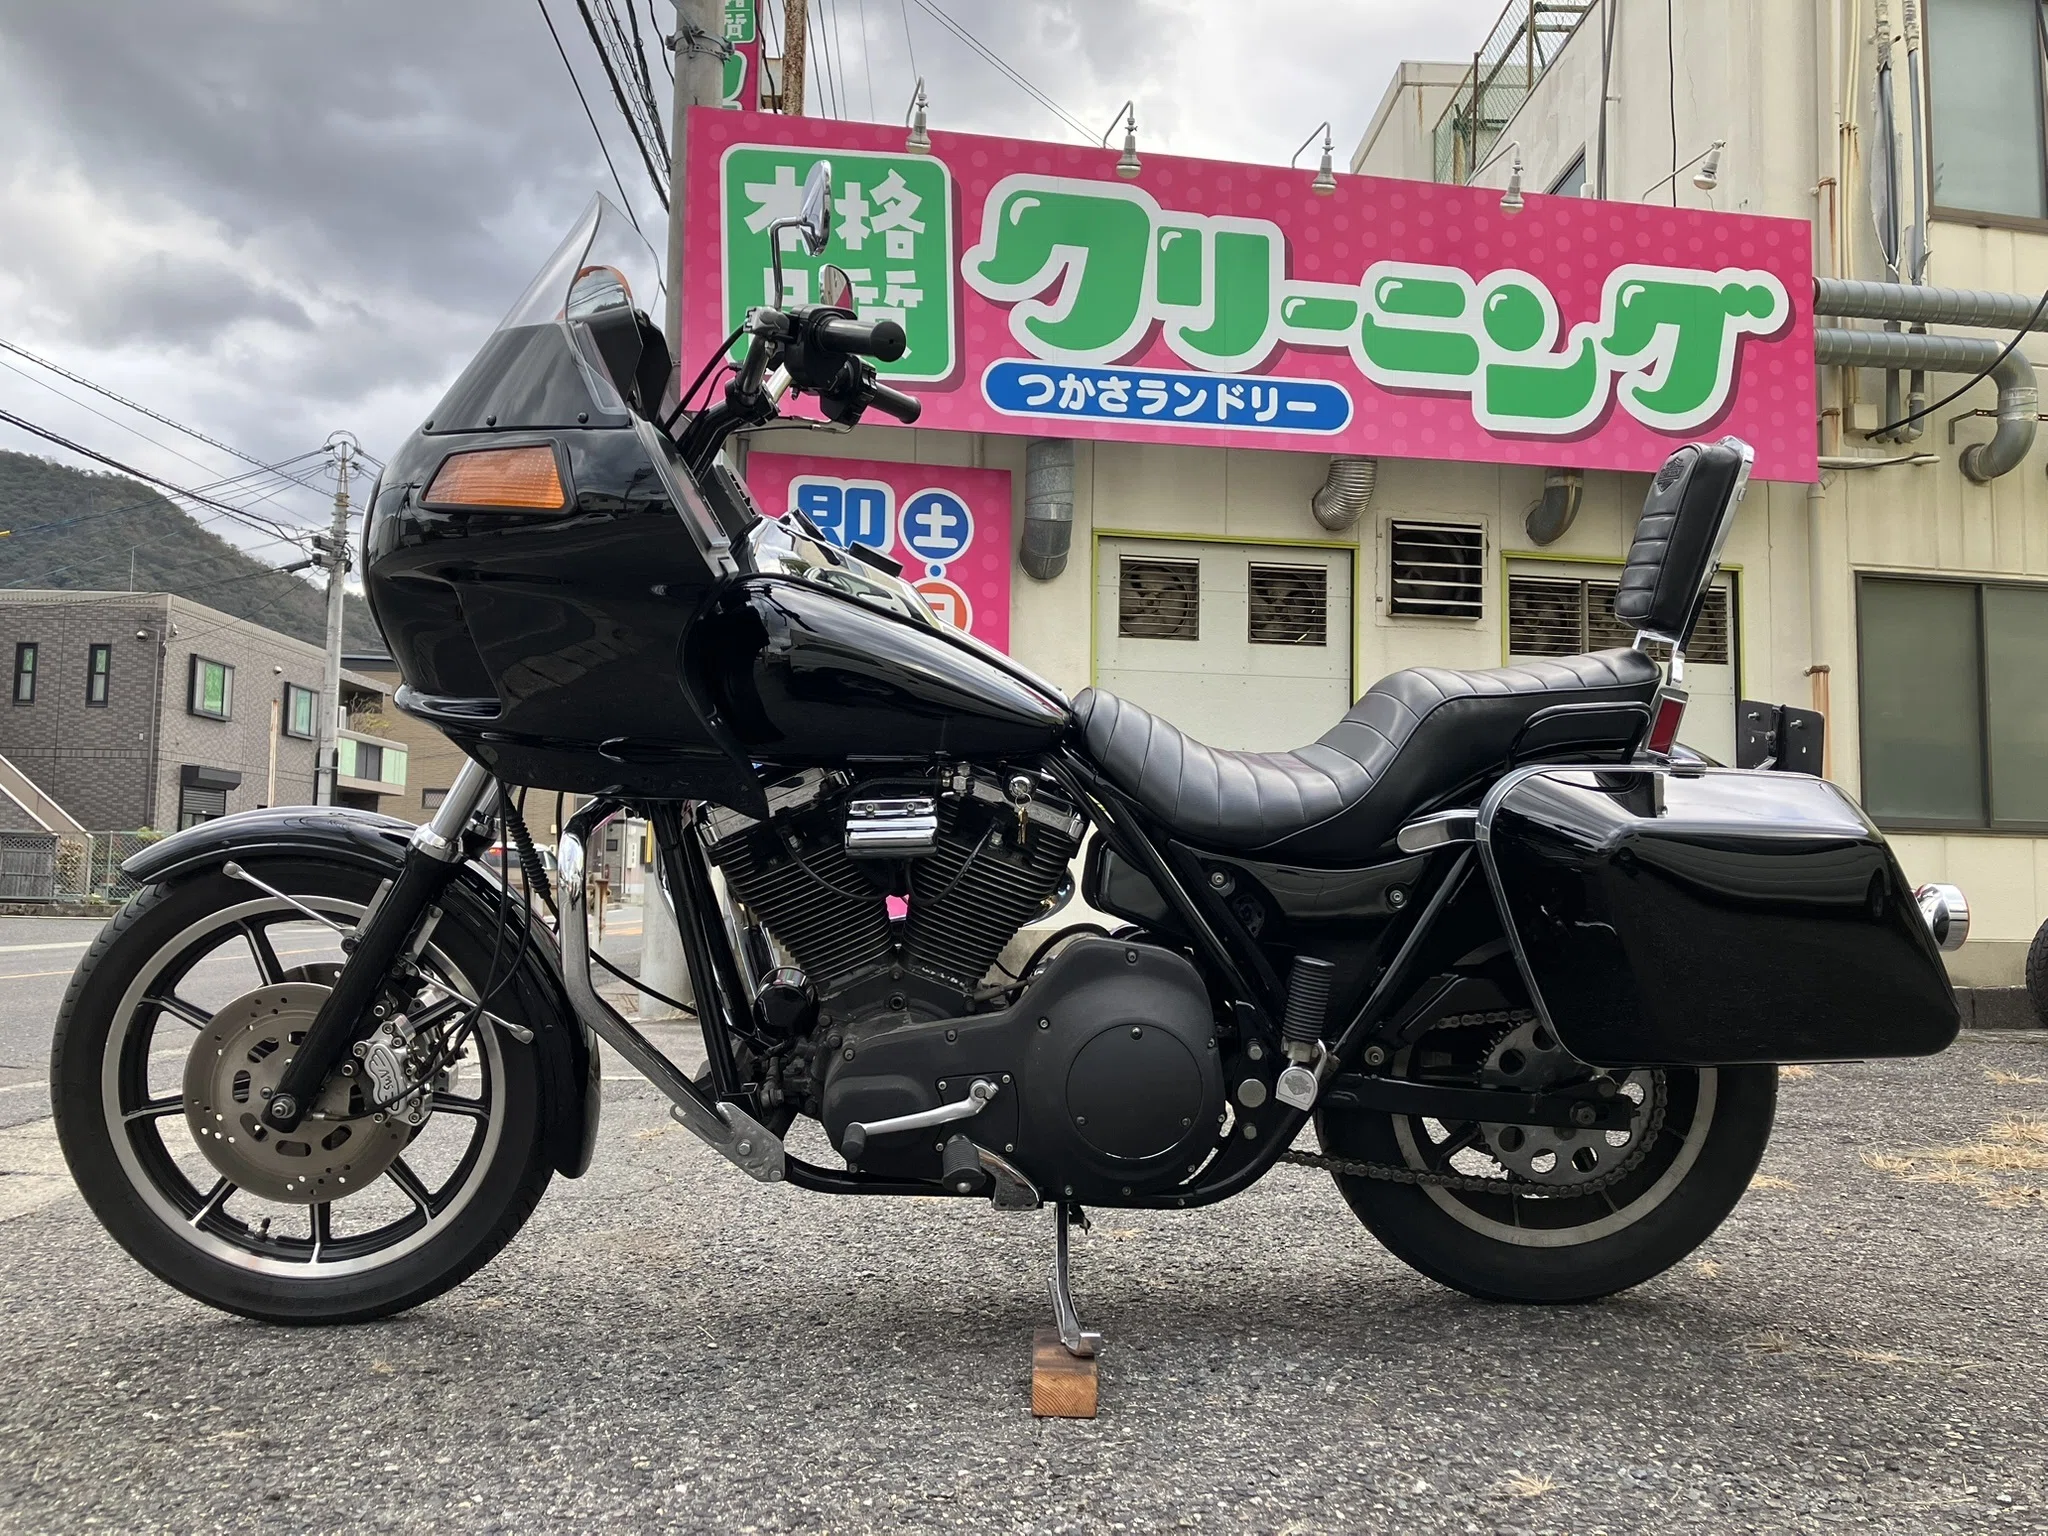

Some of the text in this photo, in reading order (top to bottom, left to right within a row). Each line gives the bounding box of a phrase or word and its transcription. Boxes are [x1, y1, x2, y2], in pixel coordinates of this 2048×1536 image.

[743, 165, 926, 259] 本格
[962, 174, 1788, 434] クリーニング
[1017, 372, 1317, 422] つかさランドリー
